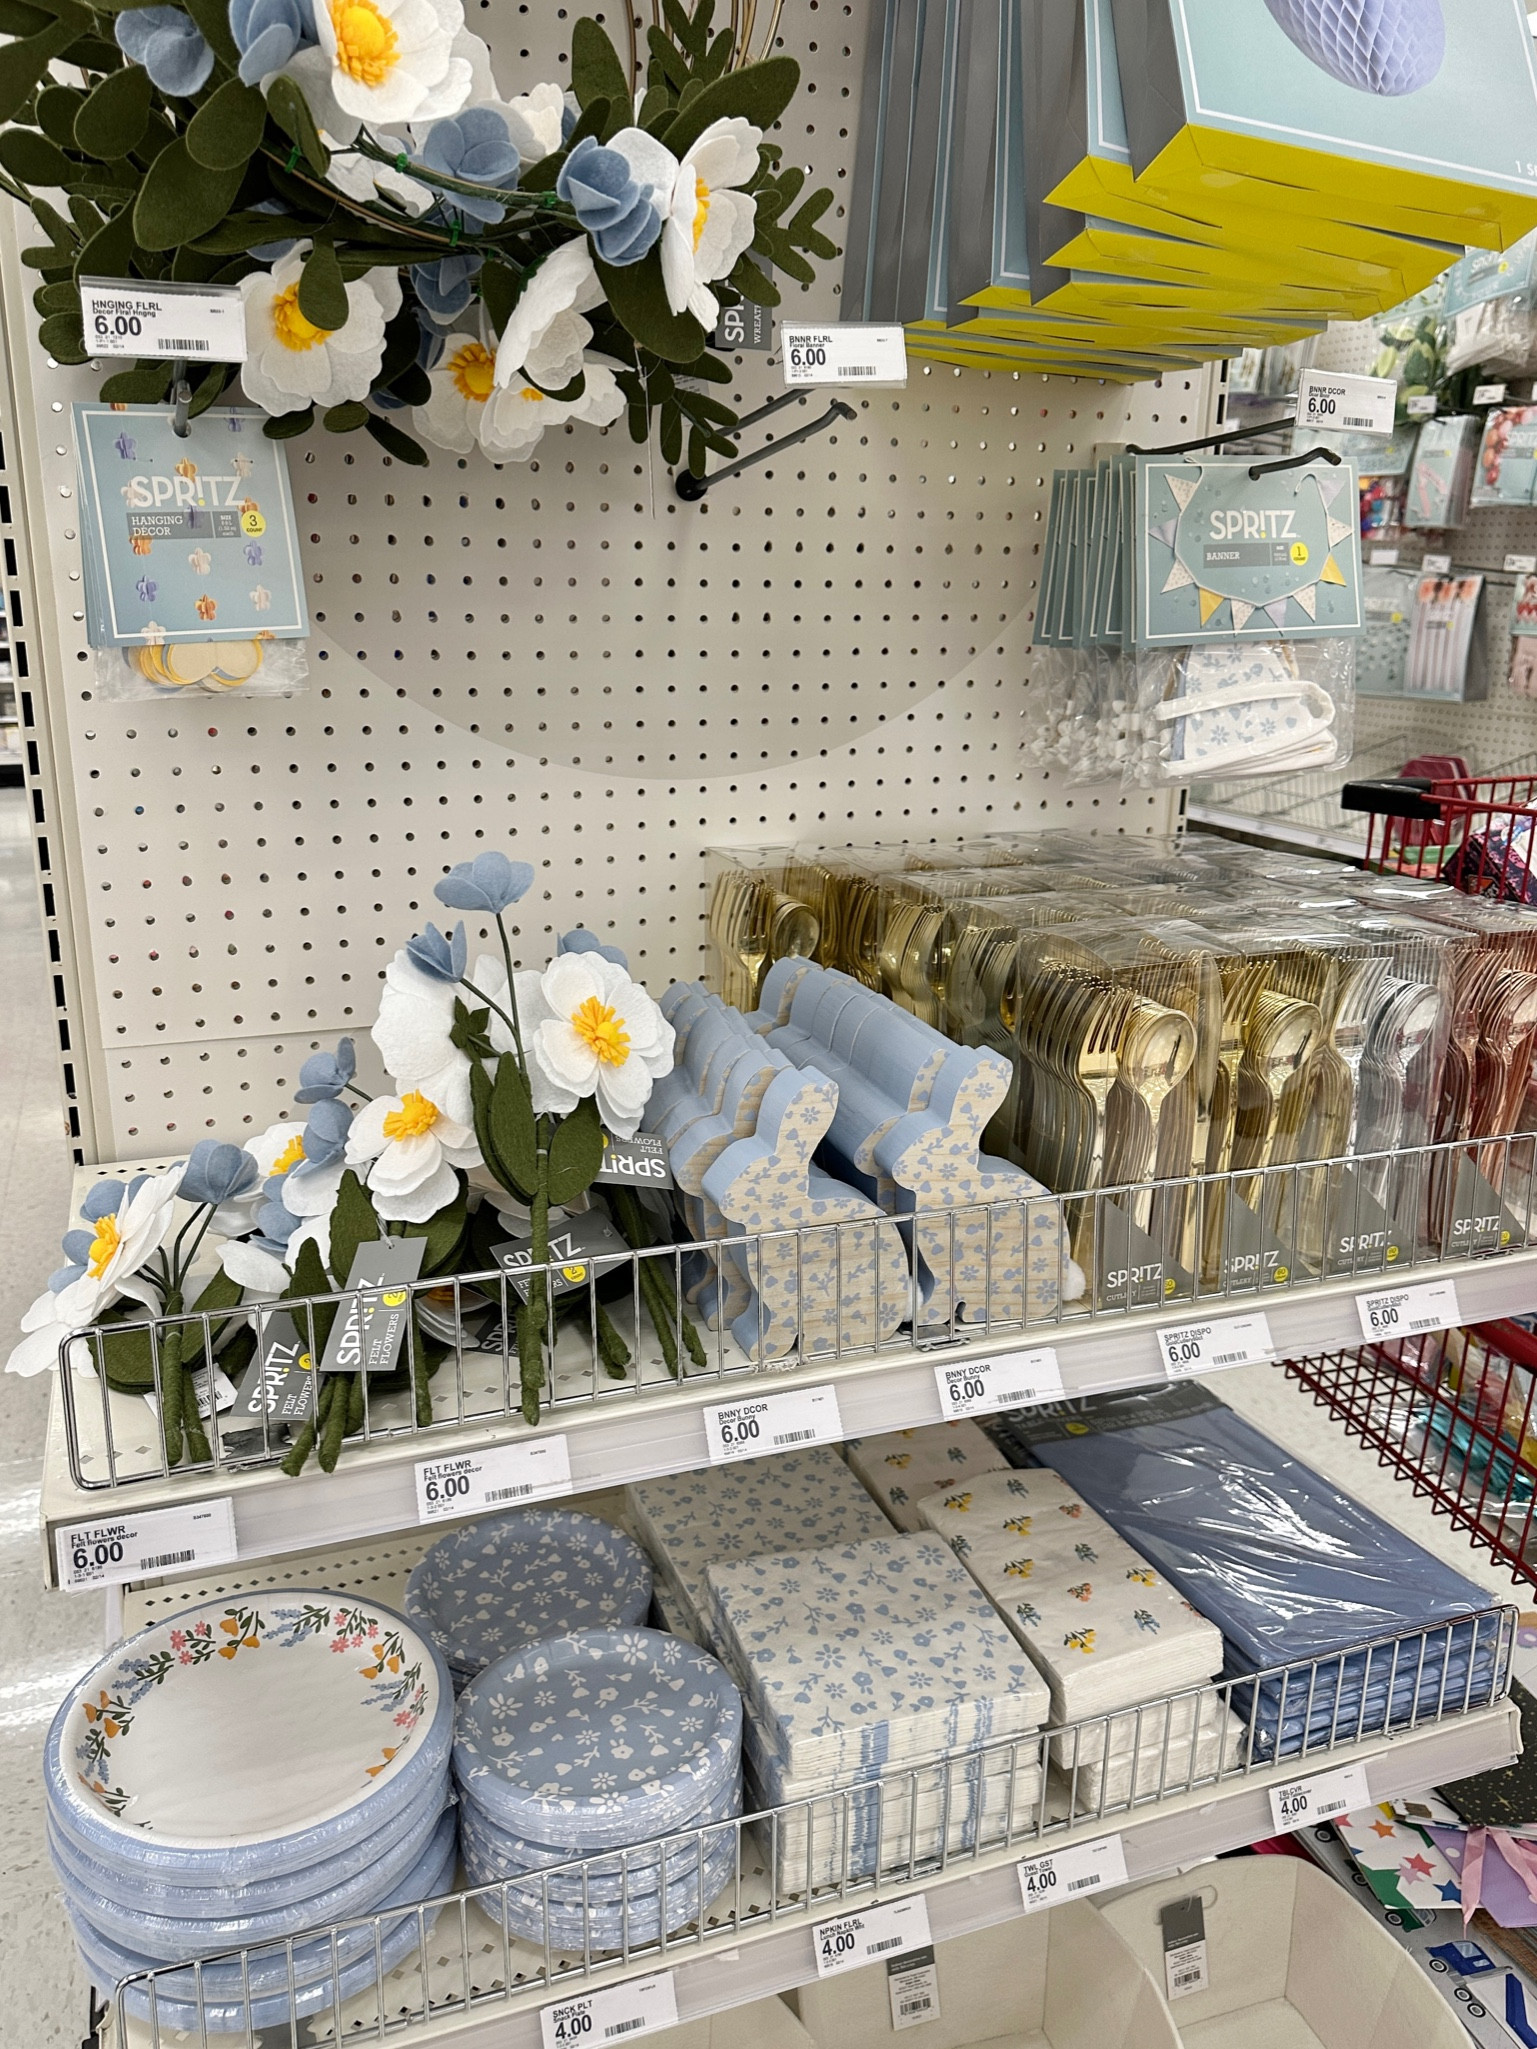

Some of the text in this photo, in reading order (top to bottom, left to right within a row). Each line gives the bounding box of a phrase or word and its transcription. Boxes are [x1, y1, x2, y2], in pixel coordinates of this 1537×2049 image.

[92, 299, 162, 312] HNGING FLRL
[95, 315, 142, 336] 6.00
[789, 336, 833, 344] BNNR FLRL
[790, 348, 826, 366] 6.00
[1309, 385, 1346, 396] BNNR DCOR
[1308, 397, 1336, 415] 6.00
[132, 515, 184, 526] HANGING
[249, 514, 258, 527] 3
[132, 524, 171, 537] DÉCOR
[1206, 552, 1240, 561] BANNER
[1296, 546, 1302, 556] 1
[640, 1146, 664, 1155] FELT
[1366, 1294, 1410, 1307] SPRITZ DISPO
[1370, 1308, 1399, 1327] 6.00
[380, 1313, 400, 1365] FLOWERS
[1164, 1330, 1190, 1342] SPRITZ
[1190, 1327, 1212, 1337] DISPO
[368, 1338, 382, 1365] FELT
[1168, 1342, 1201, 1362] 6.00
[946, 1364, 992, 1380] BNNY DCOR
[950, 1380, 985, 1402] 6.00
[281, 1393, 298, 1415] FELT
[718, 1403, 768, 1420] BNNY DCOR
[721, 1419, 760, 1444] 6.00
[423, 1460, 472, 1477] FLT FLWR
[424, 1466, 482, 1482] Felt flowers decor
[426, 1475, 470, 1501] 6.00
[70, 1524, 126, 1544] FLT FLWR
[71, 1531, 138, 1550] Felt flowers decor
[73, 1542, 124, 1569] 6.00
[1281, 1796, 1308, 1815] 4.00
[1023, 1858, 1054, 1874] TWL GST
[1027, 1870, 1057, 1892] 4.00
[820, 1918, 862, 1937] NPKIN FLRL
[822, 1933, 856, 1956] 4.00
[552, 2000, 593, 2019] SNCK PLT
[555, 2014, 592, 2040] 4.00
